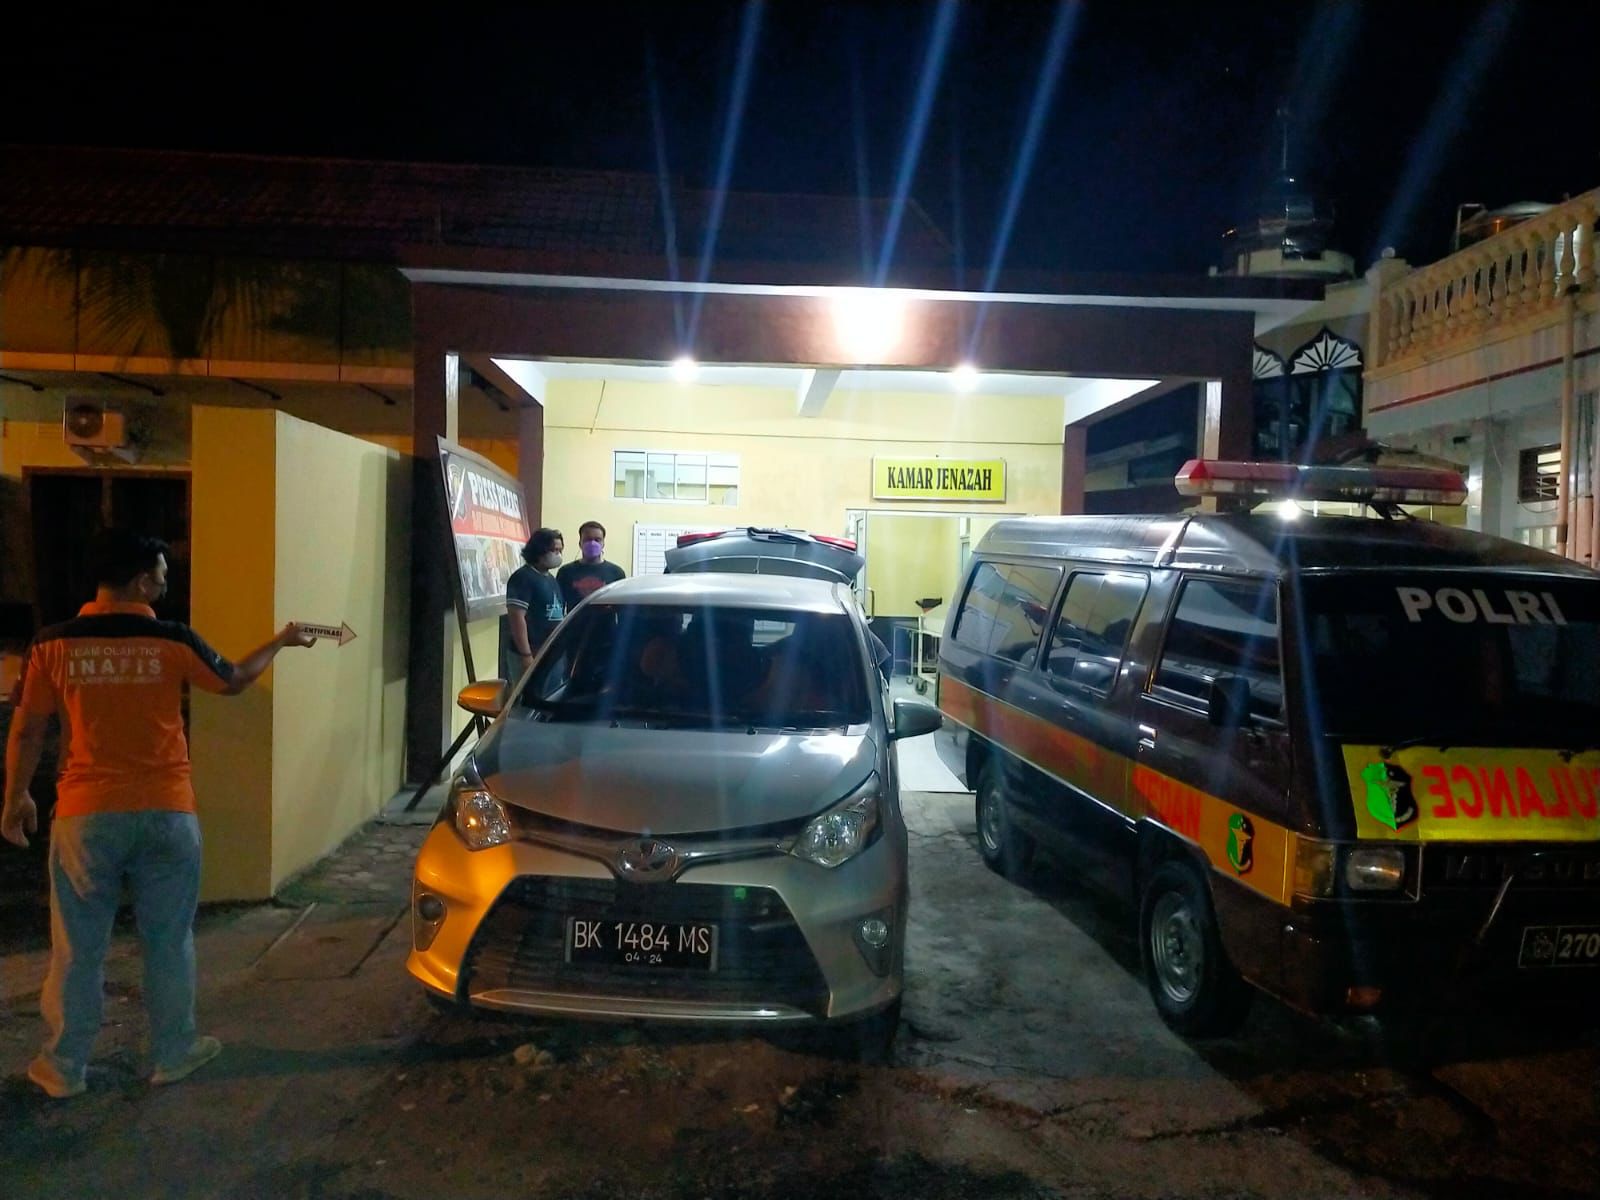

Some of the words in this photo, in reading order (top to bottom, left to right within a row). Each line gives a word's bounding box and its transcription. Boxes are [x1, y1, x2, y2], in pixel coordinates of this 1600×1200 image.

[888, 466, 933, 490] KAMAR
[936, 468, 992, 491] JENAZAH
[1395, 586, 1569, 625] POLRI
[303, 626, 342, 638] ENTIFIKASI
[68, 658, 162, 677] INAFIS
[574, 921, 602, 949] BK
[614, 922, 670, 951] 1484
[678, 925, 710, 954] MS
[1558, 932, 1600, 959] 270
